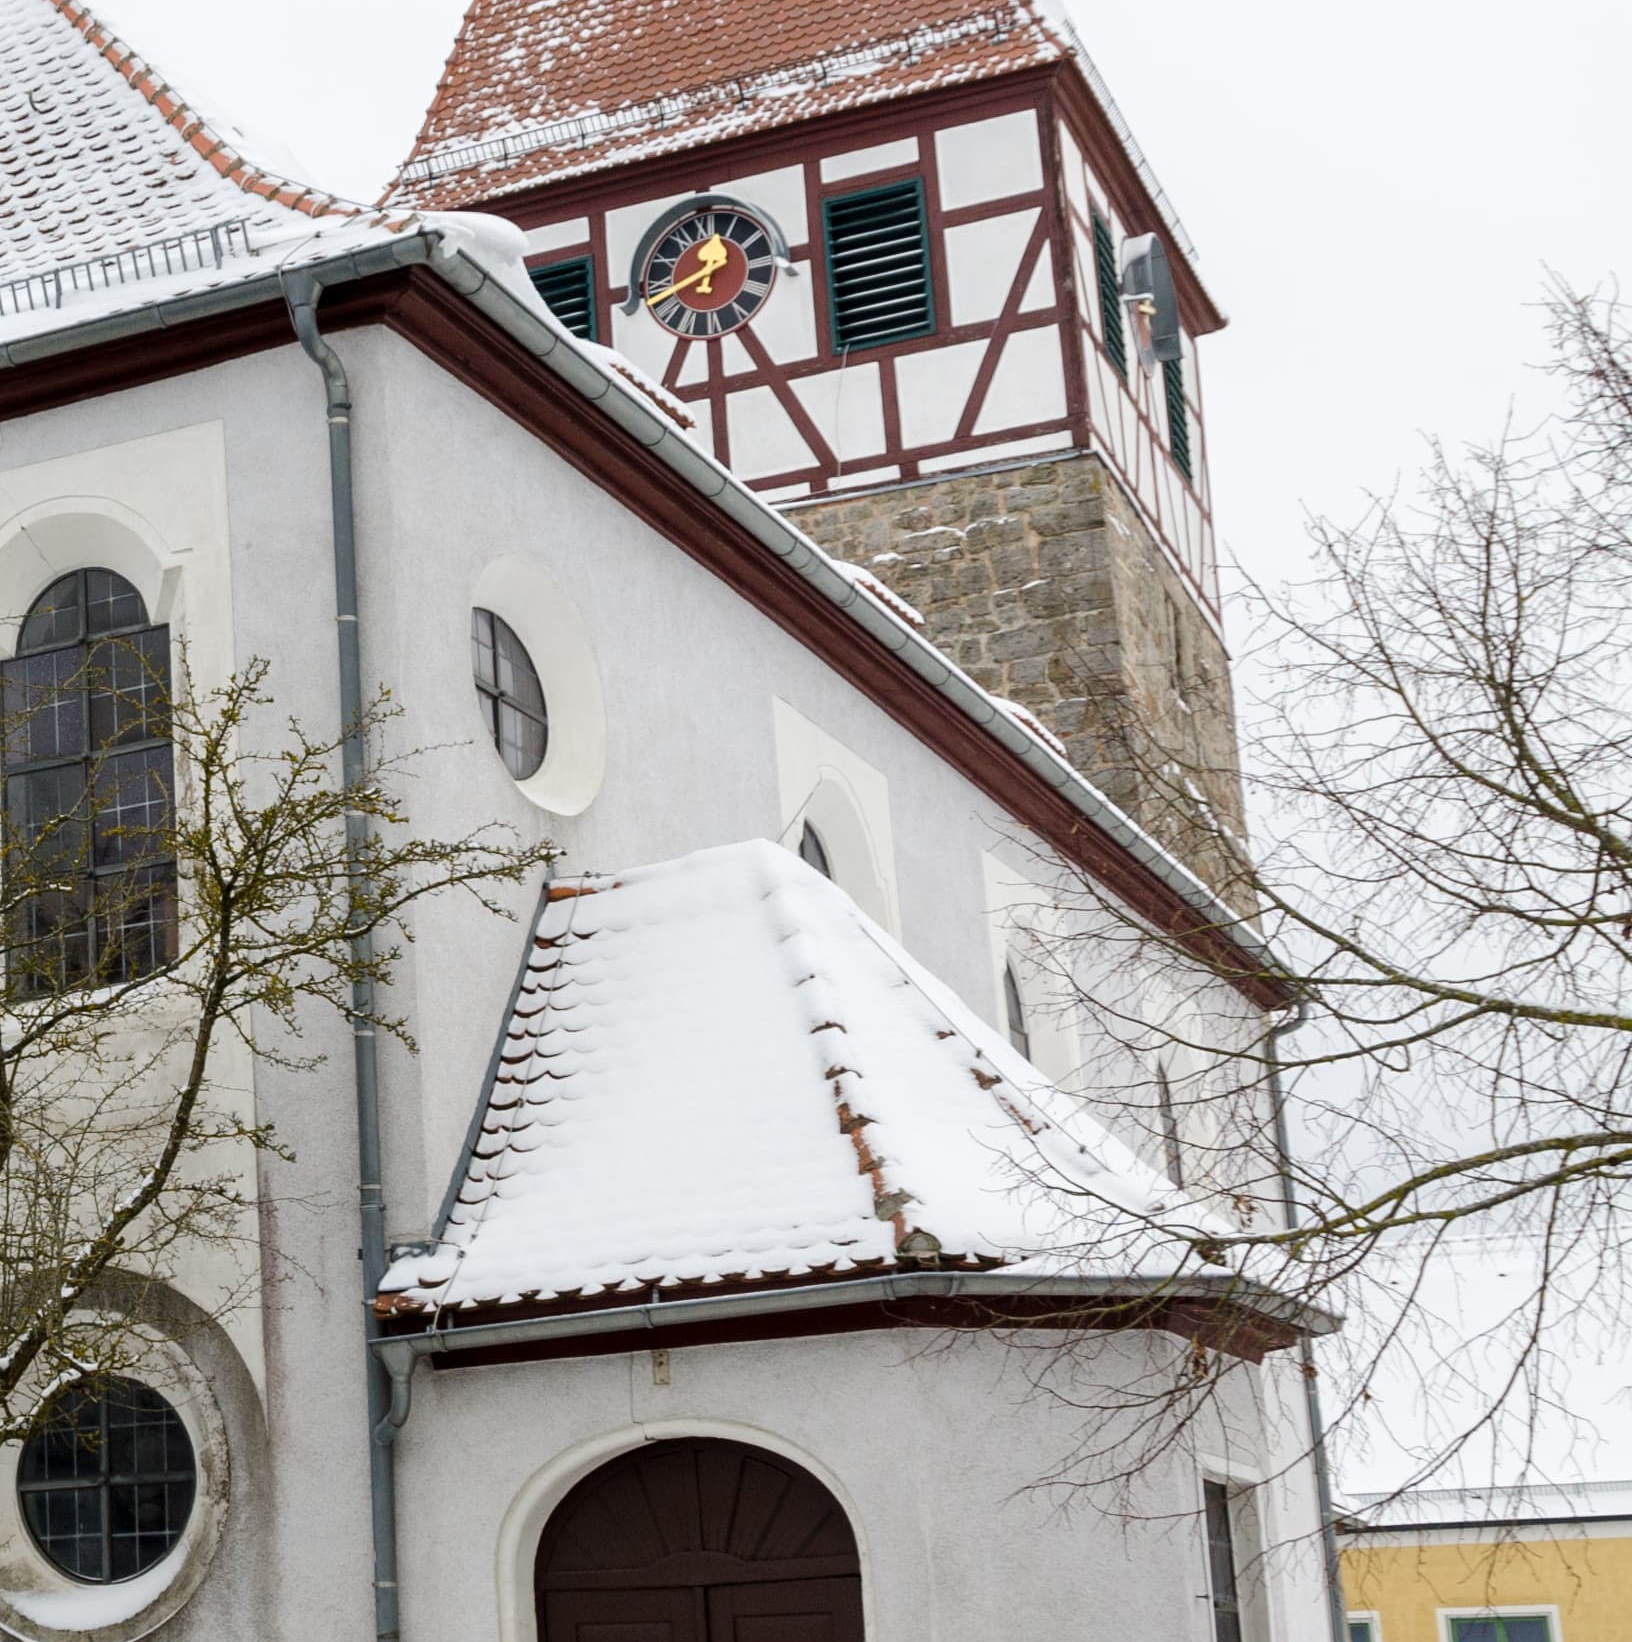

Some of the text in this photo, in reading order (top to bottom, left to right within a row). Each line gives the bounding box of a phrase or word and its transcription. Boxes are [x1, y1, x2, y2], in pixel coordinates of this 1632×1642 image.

[669, 227, 693, 251] XI
[742, 230, 763, 249] II
[653, 253, 677, 268] X
[749, 255, 772, 269] III
[732, 302, 749, 321] V
[677, 309, 696, 334] VII
[707, 312, 722, 334] VI
